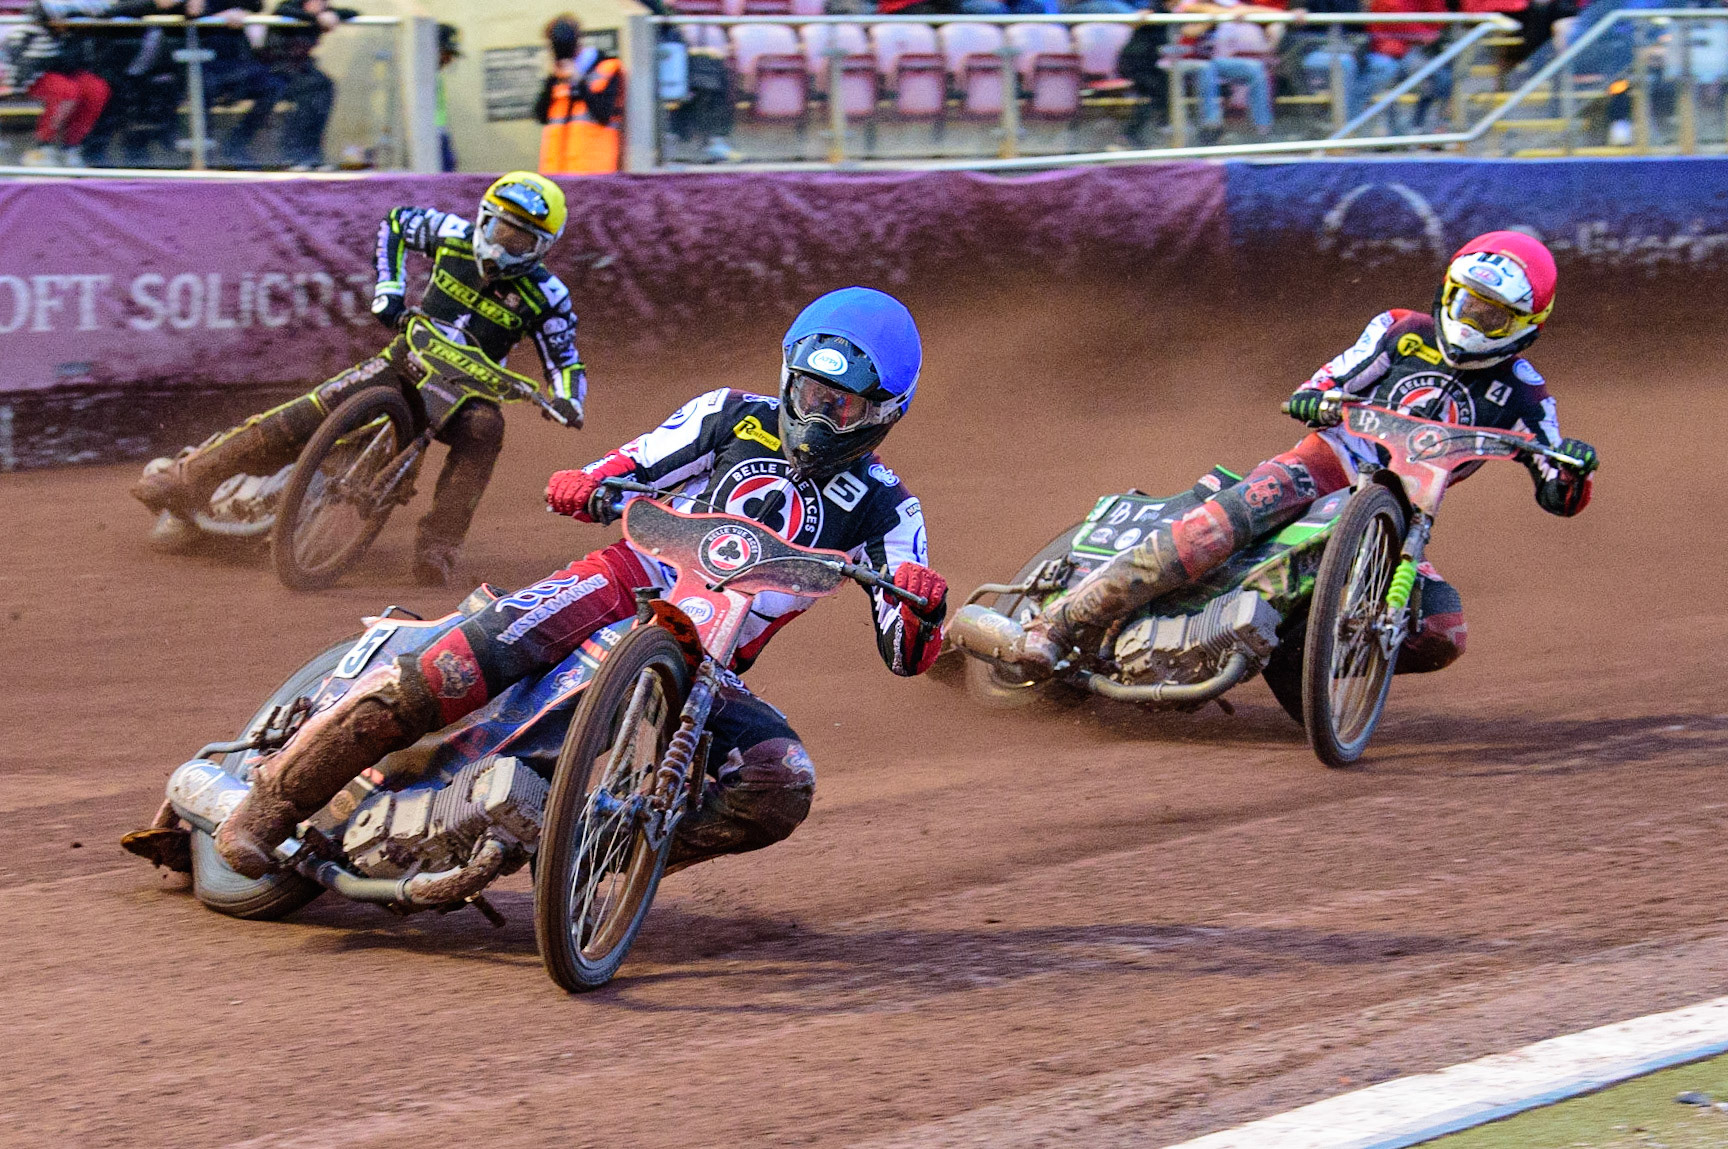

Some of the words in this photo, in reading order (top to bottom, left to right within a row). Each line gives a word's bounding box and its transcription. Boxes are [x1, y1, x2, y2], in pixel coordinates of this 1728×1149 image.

[1398, 377, 1435, 395] BELLE
[1458, 401, 1470, 424] ACE
[1490, 383, 1508, 403] 4
[731, 463, 777, 482] BELLE
[784, 466, 810, 491] VUE
[804, 496, 818, 533] ACES
[829, 475, 861, 503] 5
[707, 527, 730, 541] BELLE
[732, 527, 748, 538] VUE
[682, 605, 707, 617] ATPI
